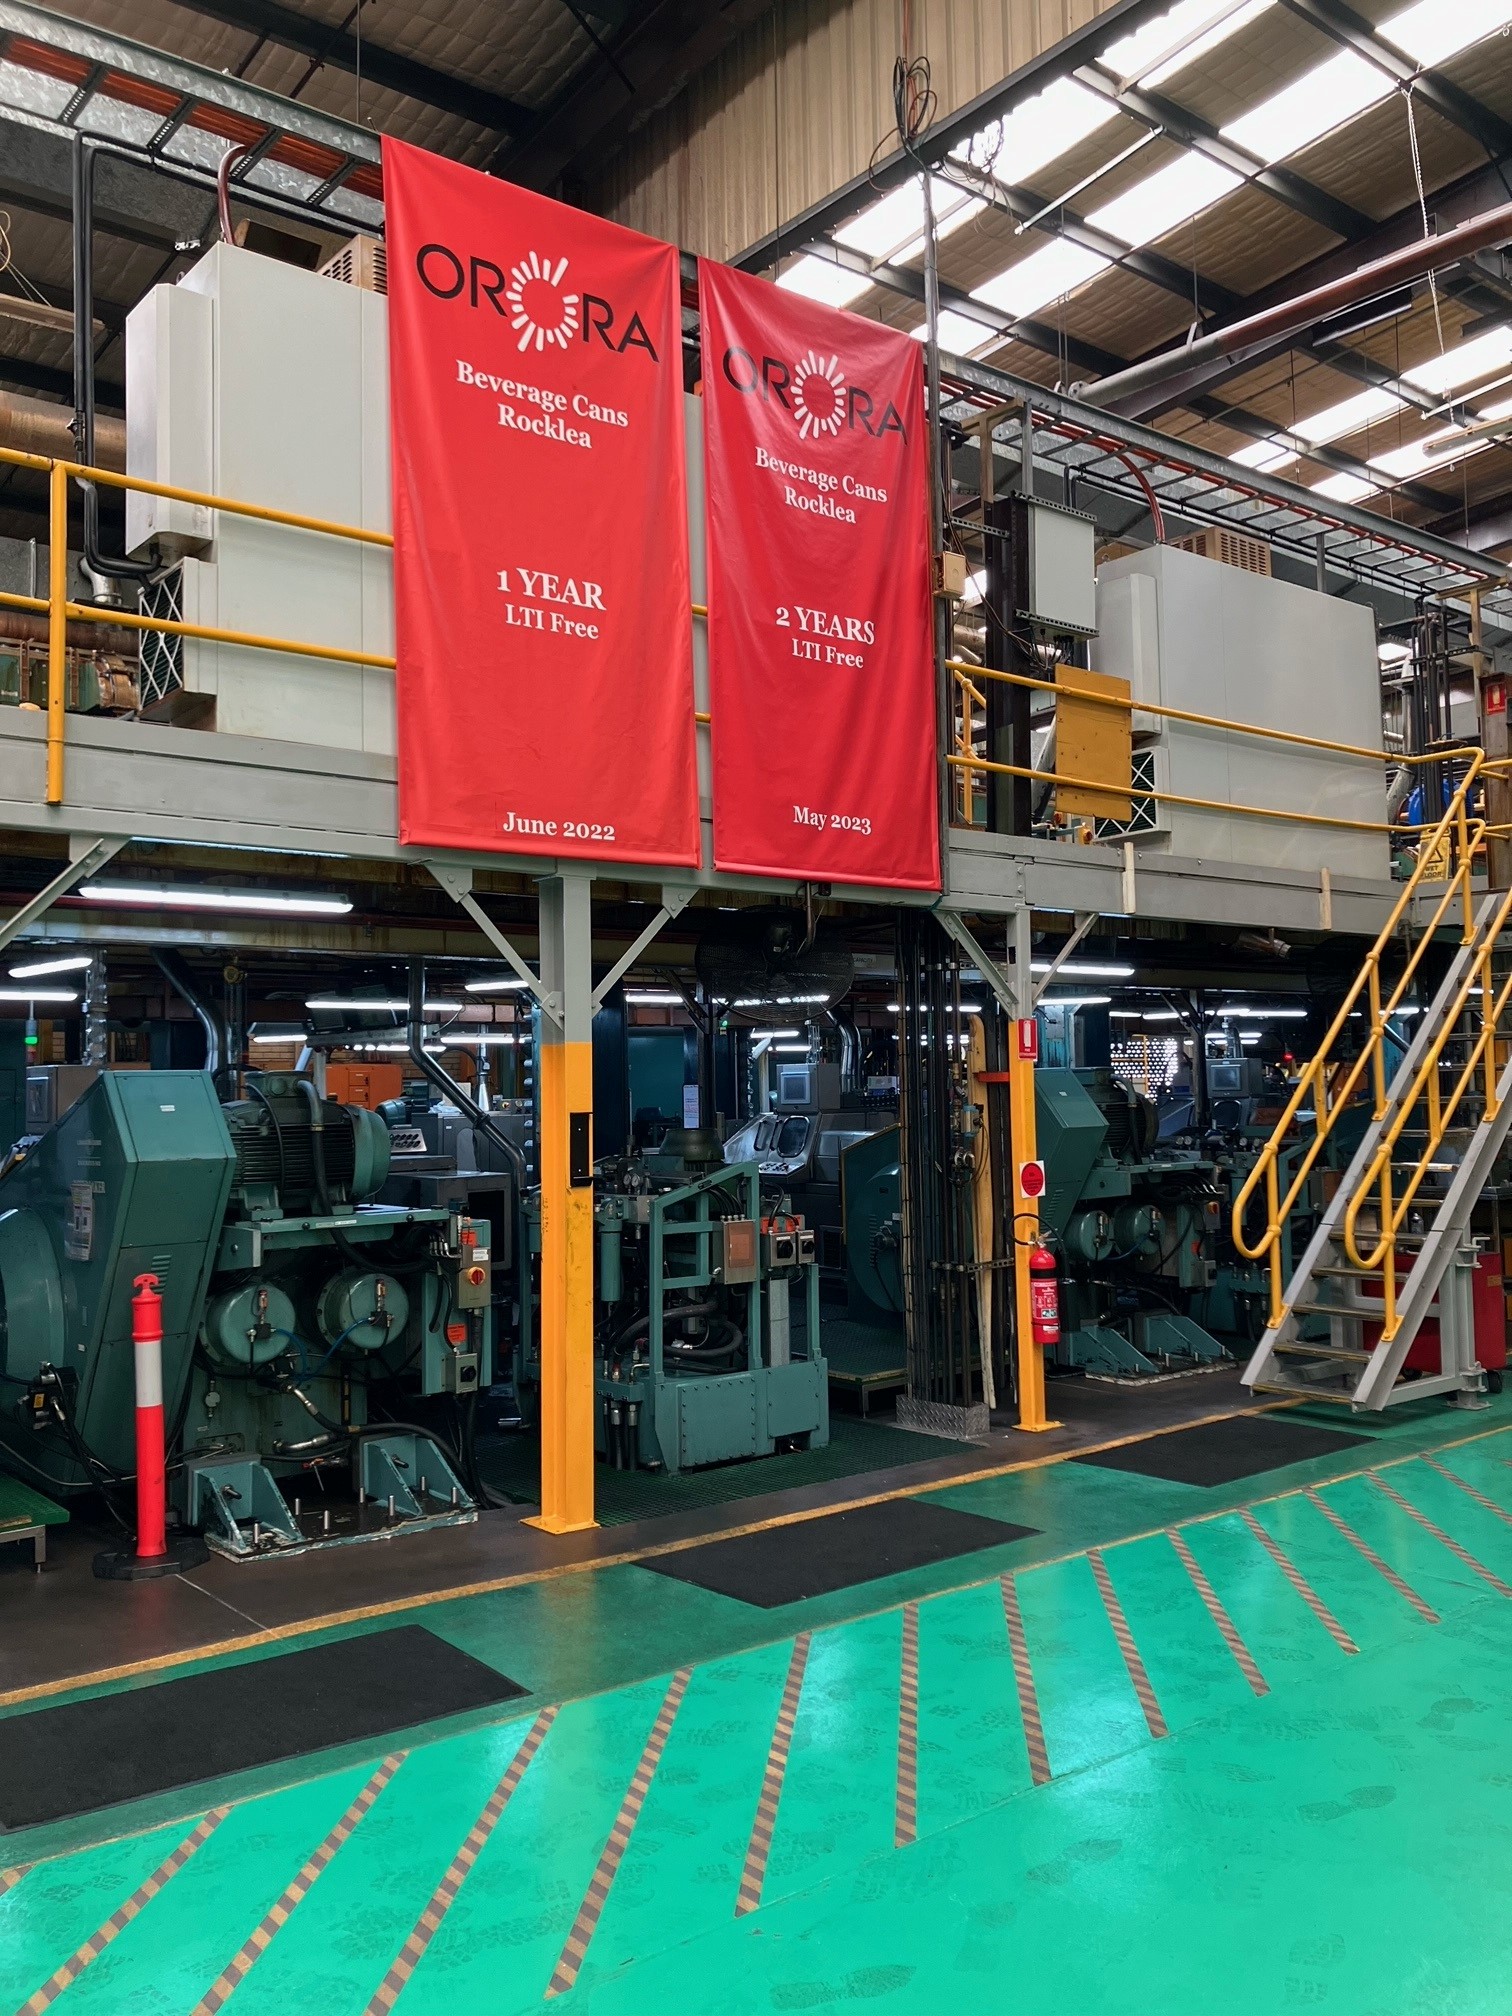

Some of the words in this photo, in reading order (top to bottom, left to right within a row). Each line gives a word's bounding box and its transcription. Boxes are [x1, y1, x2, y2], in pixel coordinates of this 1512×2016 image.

[416, 243, 660, 363] ORORA
[456, 359, 568, 413] Beverage
[572, 394, 629, 428] Cans
[722, 347, 908, 448] ORORA
[497, 403, 593, 449] Rocklea
[755, 446, 839, 492] Beverage
[842, 475, 888, 504] Cans
[783, 485, 857, 524] Rocklea
[496, 570, 511, 592] 1
[516, 567, 607, 611] YEAR
[505, 603, 545, 630] LTI
[549, 611, 599, 640] Free
[776, 606, 791, 627] 2
[793, 605, 875, 645] YEARS
[792, 638, 821, 661] LTI
[825, 645, 864, 669] Free
[502, 811, 558, 836] June
[562, 821, 616, 841] 2022
[793, 805, 826, 834] May
[830, 814, 872, 836] 2023
